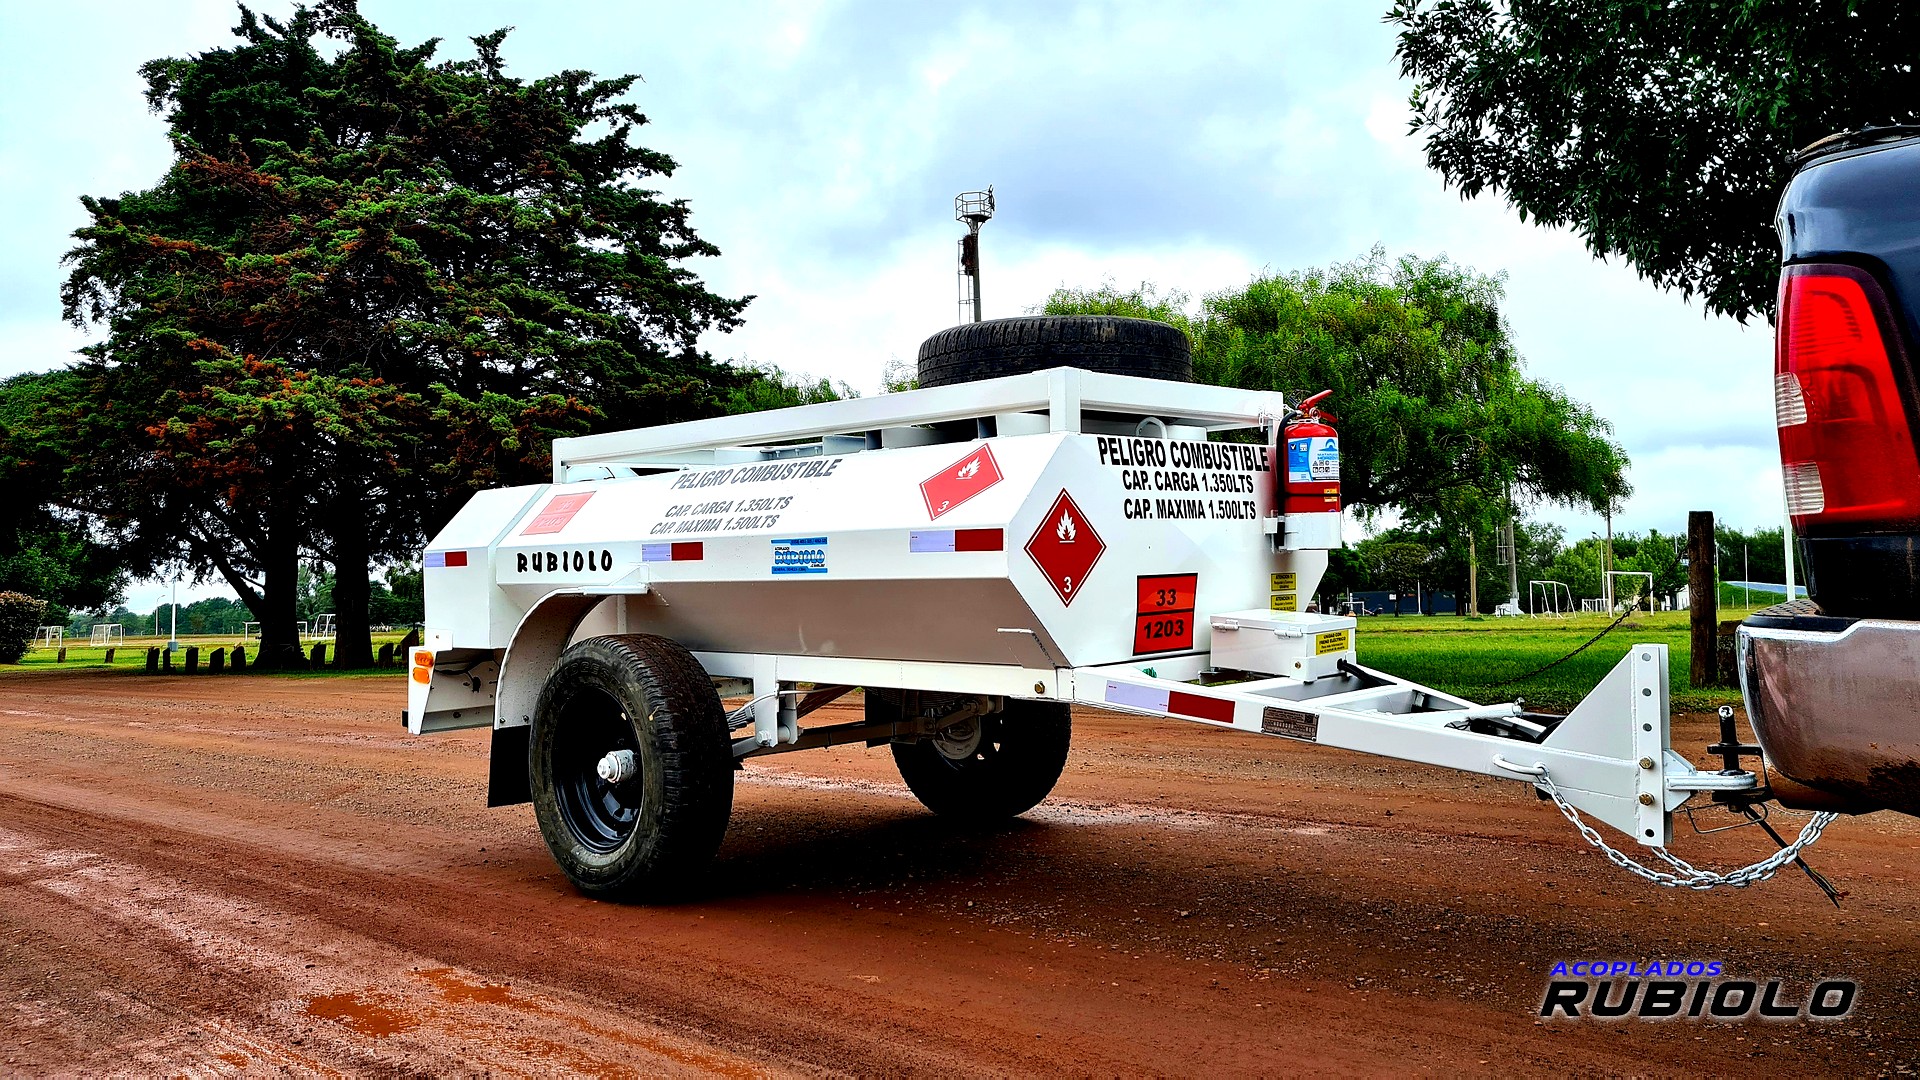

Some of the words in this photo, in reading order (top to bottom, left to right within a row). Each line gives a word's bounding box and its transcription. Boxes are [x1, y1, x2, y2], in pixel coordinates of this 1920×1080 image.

[1097, 437, 1166, 467] PELIGRO
[1170, 441, 1270, 472] COMBUSTIBLE
[671, 468, 734, 490] PELIGRO
[731, 458, 842, 484] COMBUSTIBLE
[1122, 470, 1151, 491] CAP.
[1154, 471, 1199, 492] CARGA
[1202, 472, 1254, 494] 1.350LTS
[665, 505, 689, 518] CAP.
[691, 500, 734, 516] CARGA
[734, 496, 794, 513] 1.350LTS
[937, 500, 950, 512] 3
[1124, 498, 1153, 520] CAP.
[1156, 499, 1206, 520] MAXIMA
[1209, 499, 1256, 520] 1.500LTS
[650, 522, 674, 535] CAP.
[674, 517, 723, 533] MAXIMA
[722, 514, 780, 531] 1.500LTS
[516, 549, 613, 574] RUBIOLO
[775, 549, 825, 565] RUBIOLO
[1063, 576, 1072, 593] 3
[1156, 588, 1177, 607] 33
[1143, 619, 1184, 639] 1203
